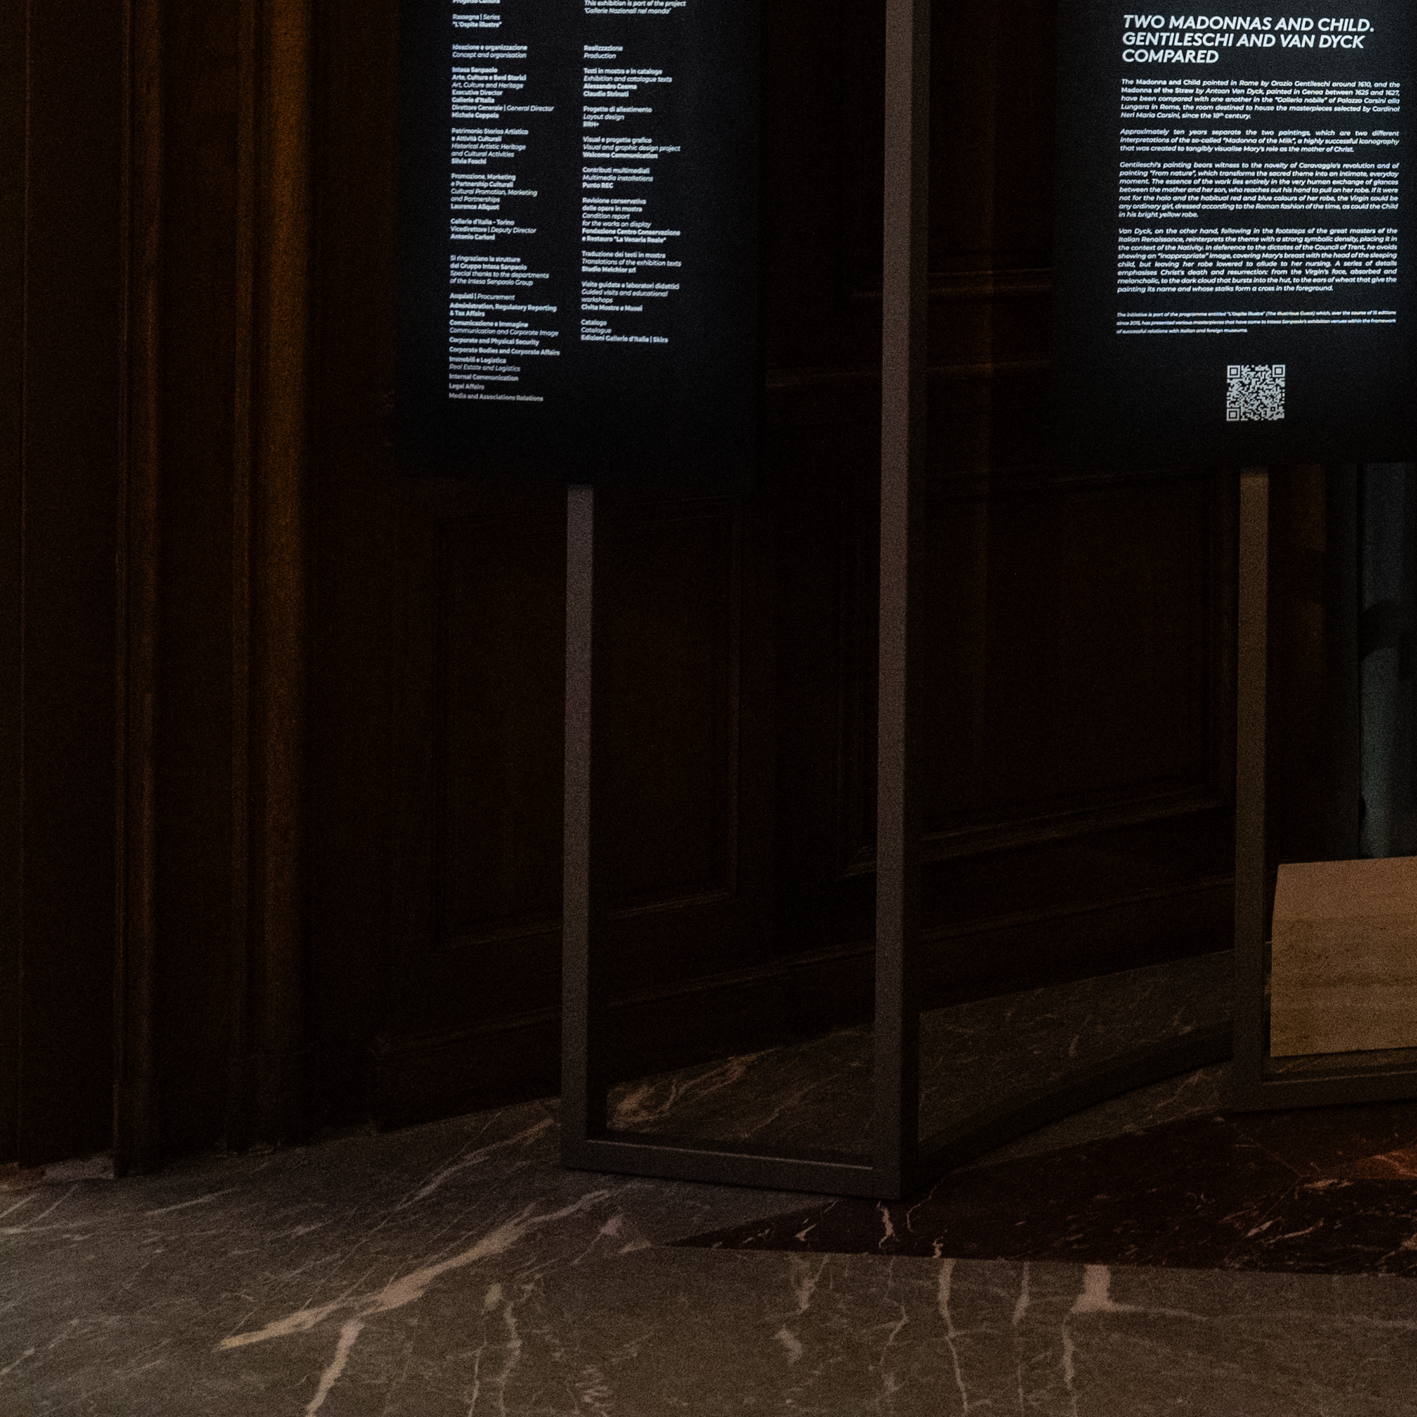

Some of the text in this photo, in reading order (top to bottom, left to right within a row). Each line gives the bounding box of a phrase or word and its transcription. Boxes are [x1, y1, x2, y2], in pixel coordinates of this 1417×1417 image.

[1123, 14, 1374, 32] TWO MADONNAS AND CHILD.
[1122, 31, 1365, 48] GENTILESCHI AND VAN DYCK
[1122, 48, 1219, 63] COMPARED
[1277, 129, 1311, 137] paintings,
